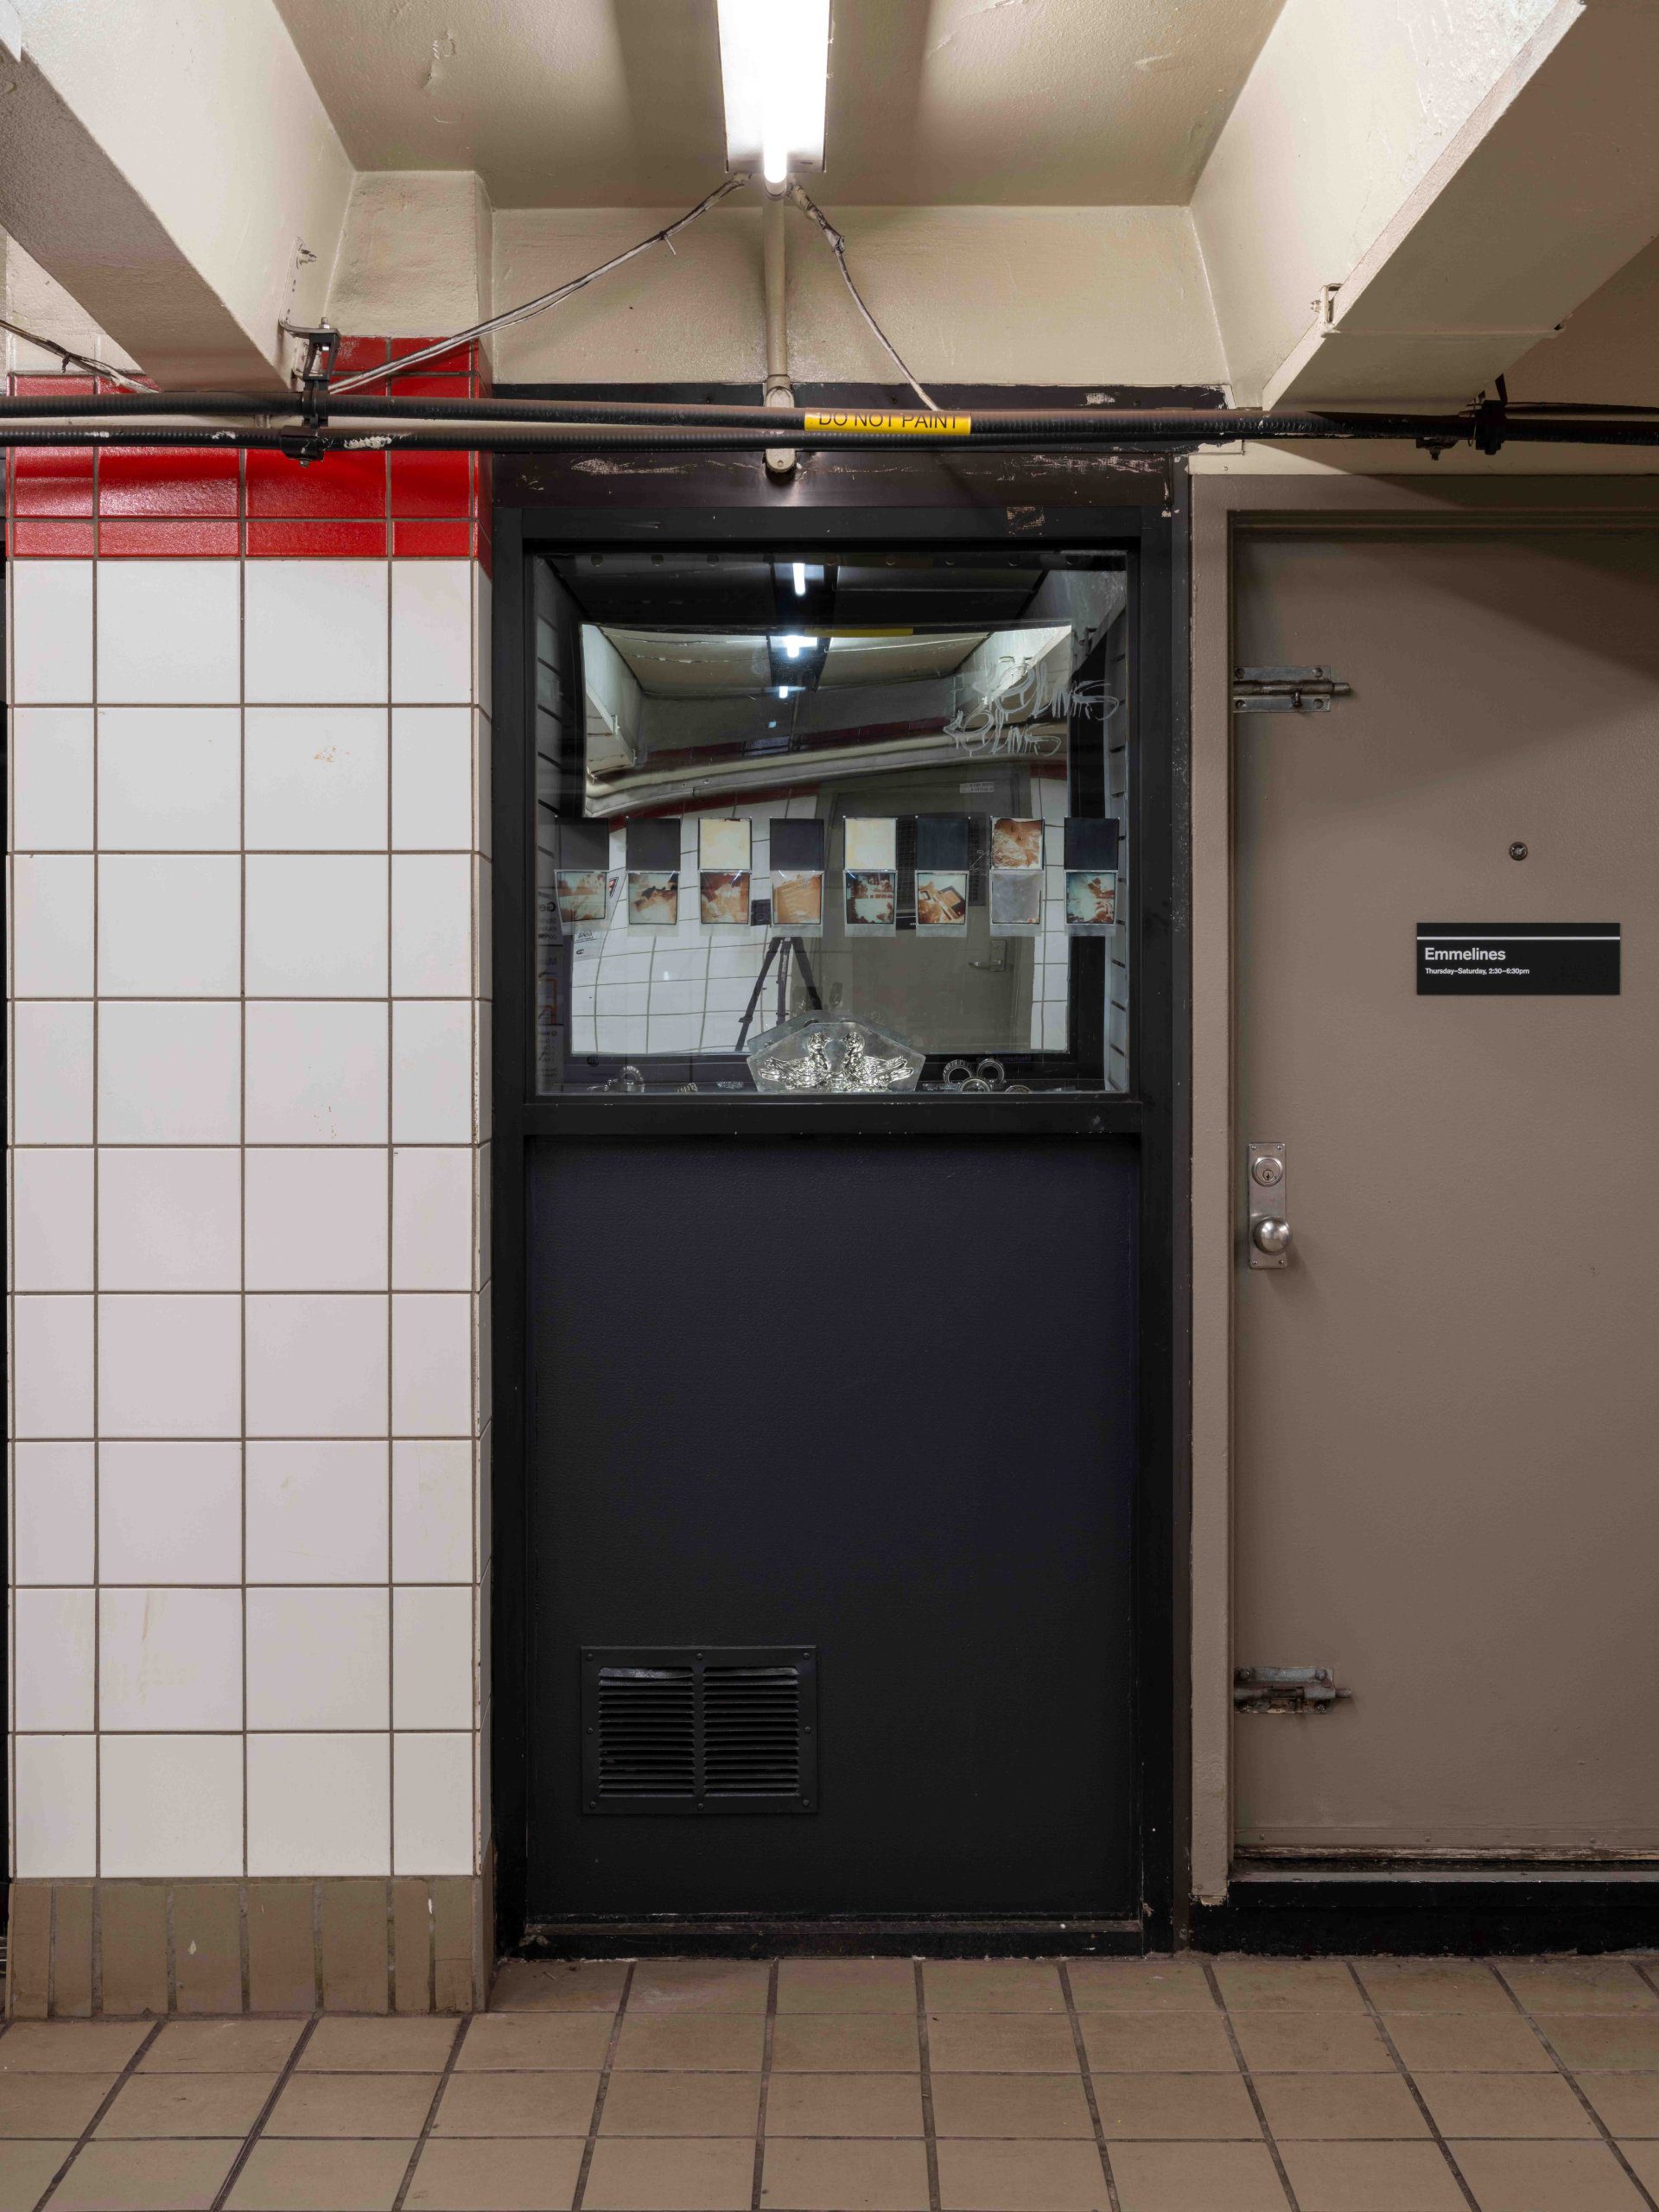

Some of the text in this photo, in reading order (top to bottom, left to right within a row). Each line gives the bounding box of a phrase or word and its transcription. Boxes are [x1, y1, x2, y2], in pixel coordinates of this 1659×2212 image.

[819, 412, 957, 429] DO NOT PAINT
[1424, 947, 1506, 961] Emmelines
